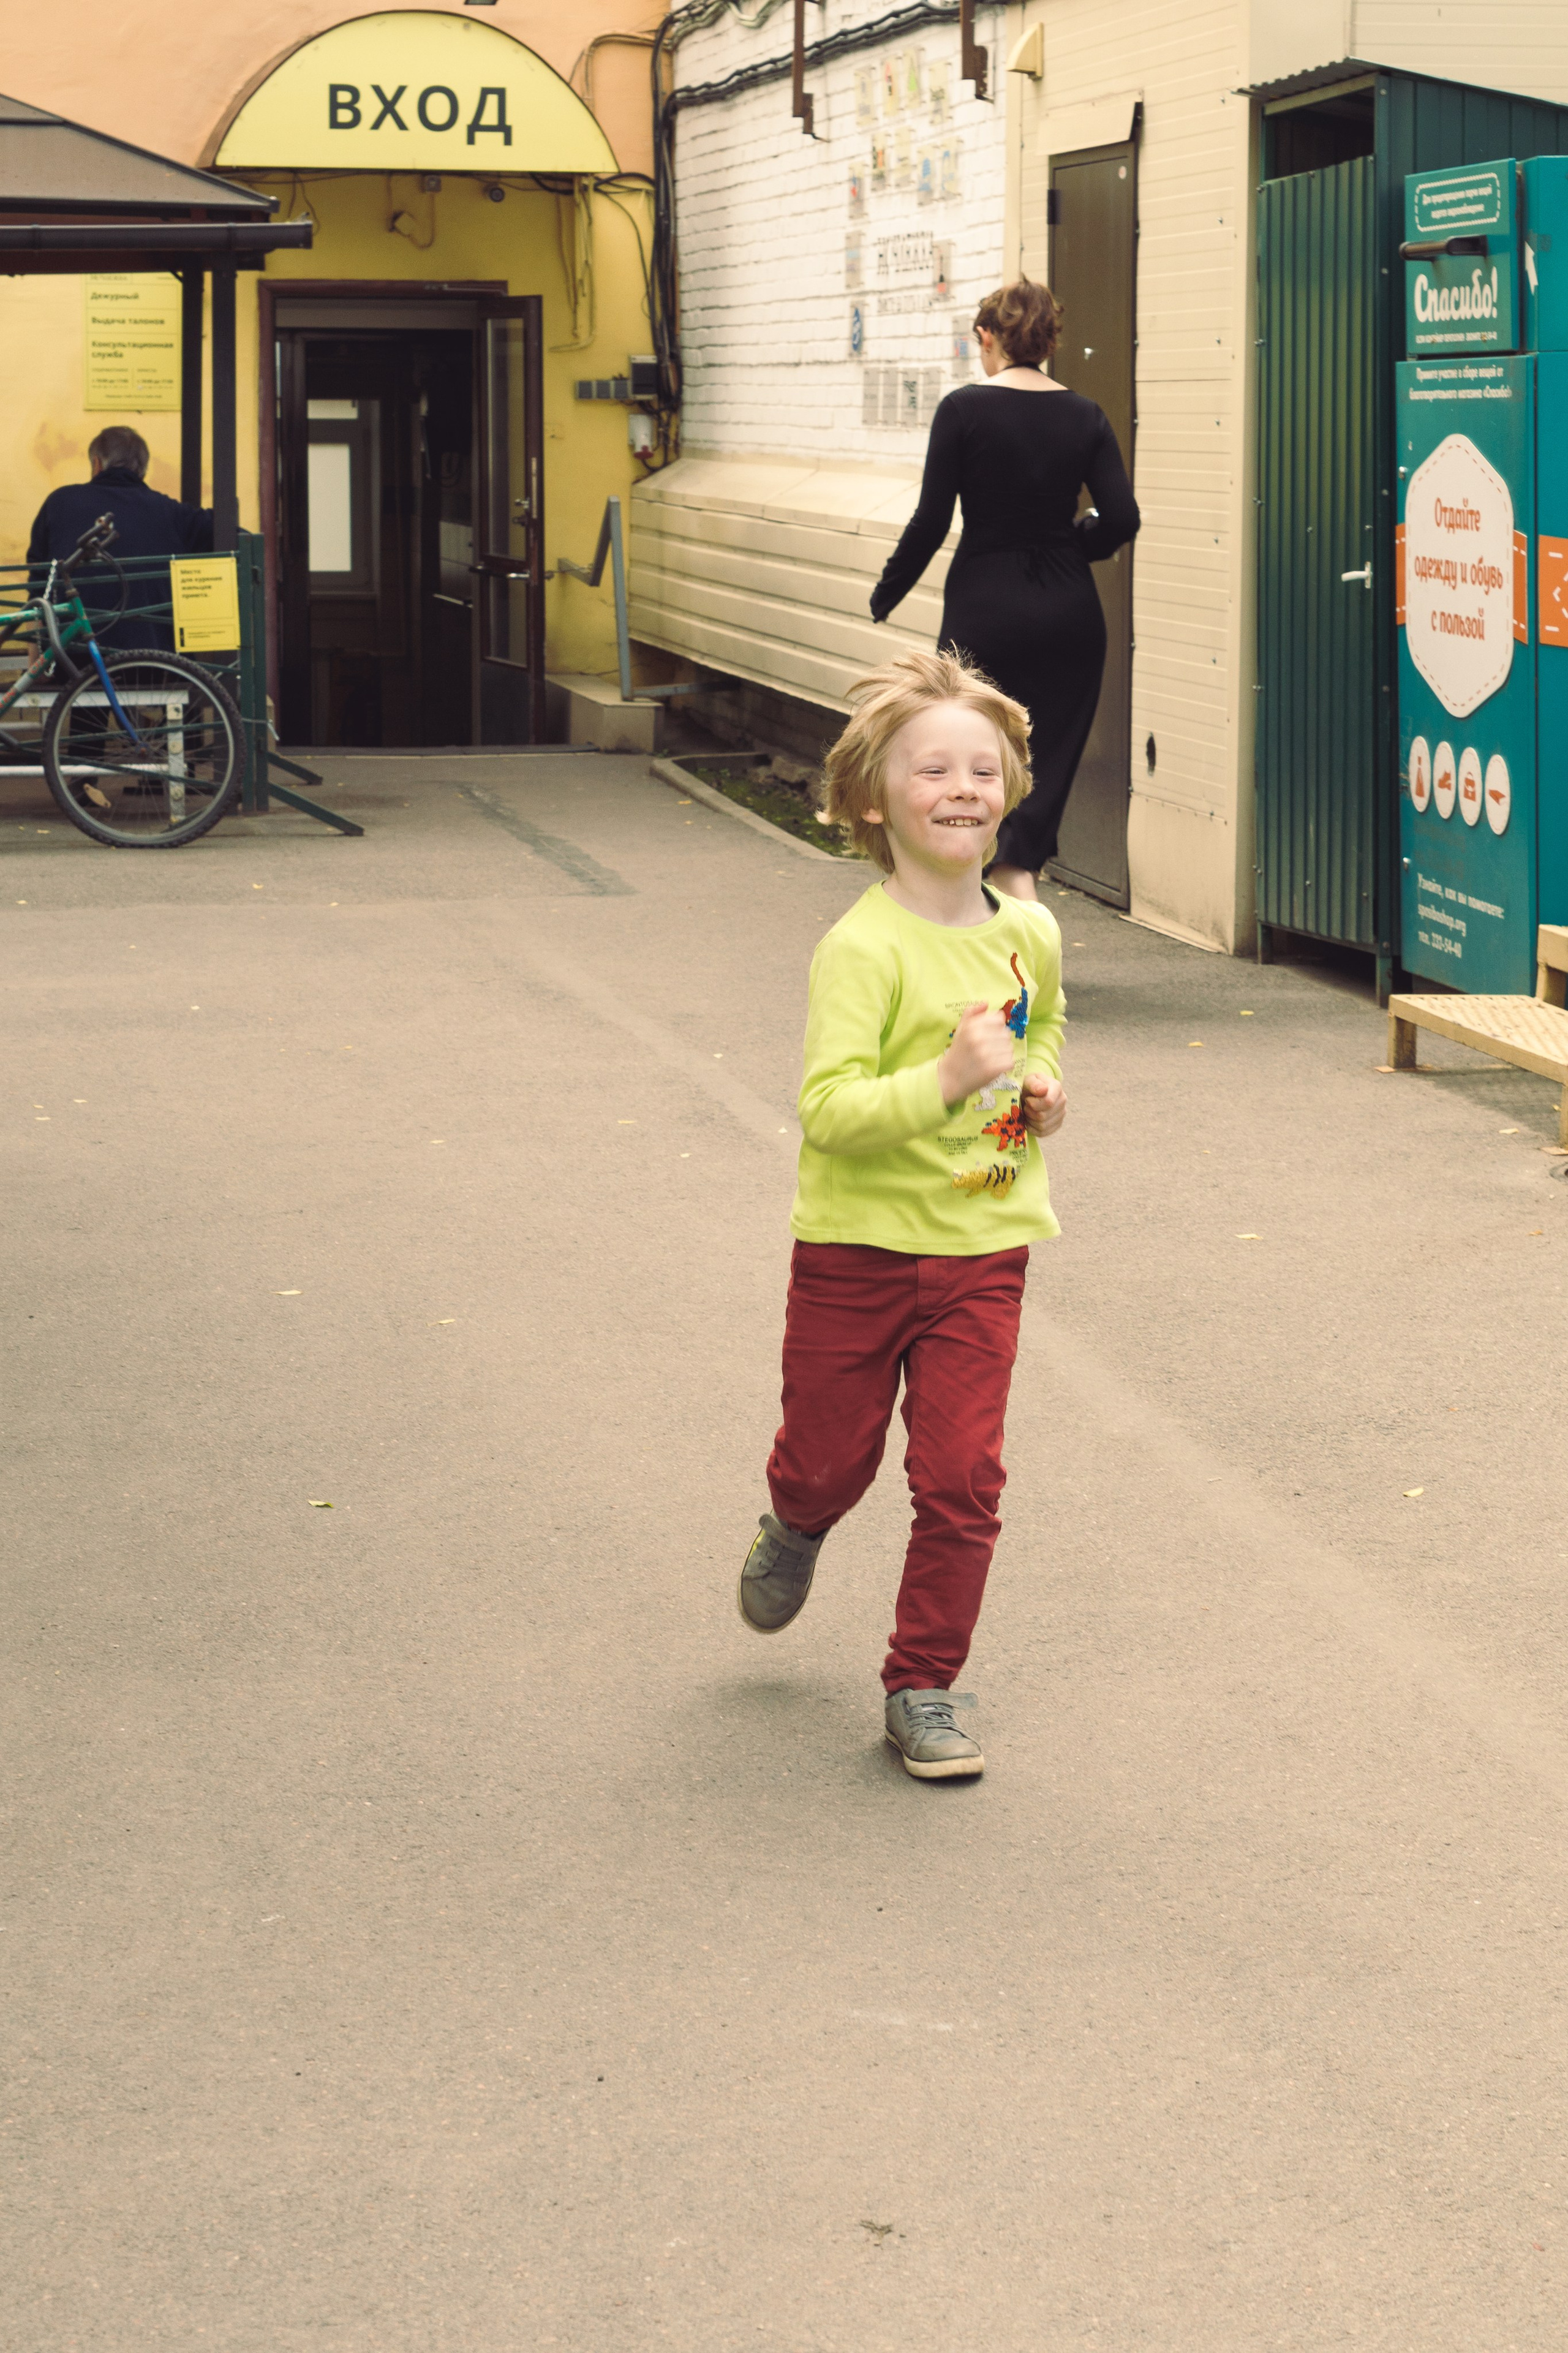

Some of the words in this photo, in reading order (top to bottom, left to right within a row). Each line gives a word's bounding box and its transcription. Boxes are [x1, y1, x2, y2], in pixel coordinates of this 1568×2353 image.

[329, 84, 512, 146] ВХОД
[91, 292, 140, 301] Дежурный
[1414, 265, 1498, 323] Спасибо!
[91, 316, 126, 325] Выдача
[91, 341, 174, 350] Консультационная
[91, 351, 124, 360] служба
[1434, 497, 1480, 534] Отдайте
[1415, 555, 1457, 591] одежду
[1460, 562, 1468, 584] и
[1471, 555, 1504, 595] обувь
[1431, 610, 1437, 632] с
[1439, 607, 1485, 641] пользой
